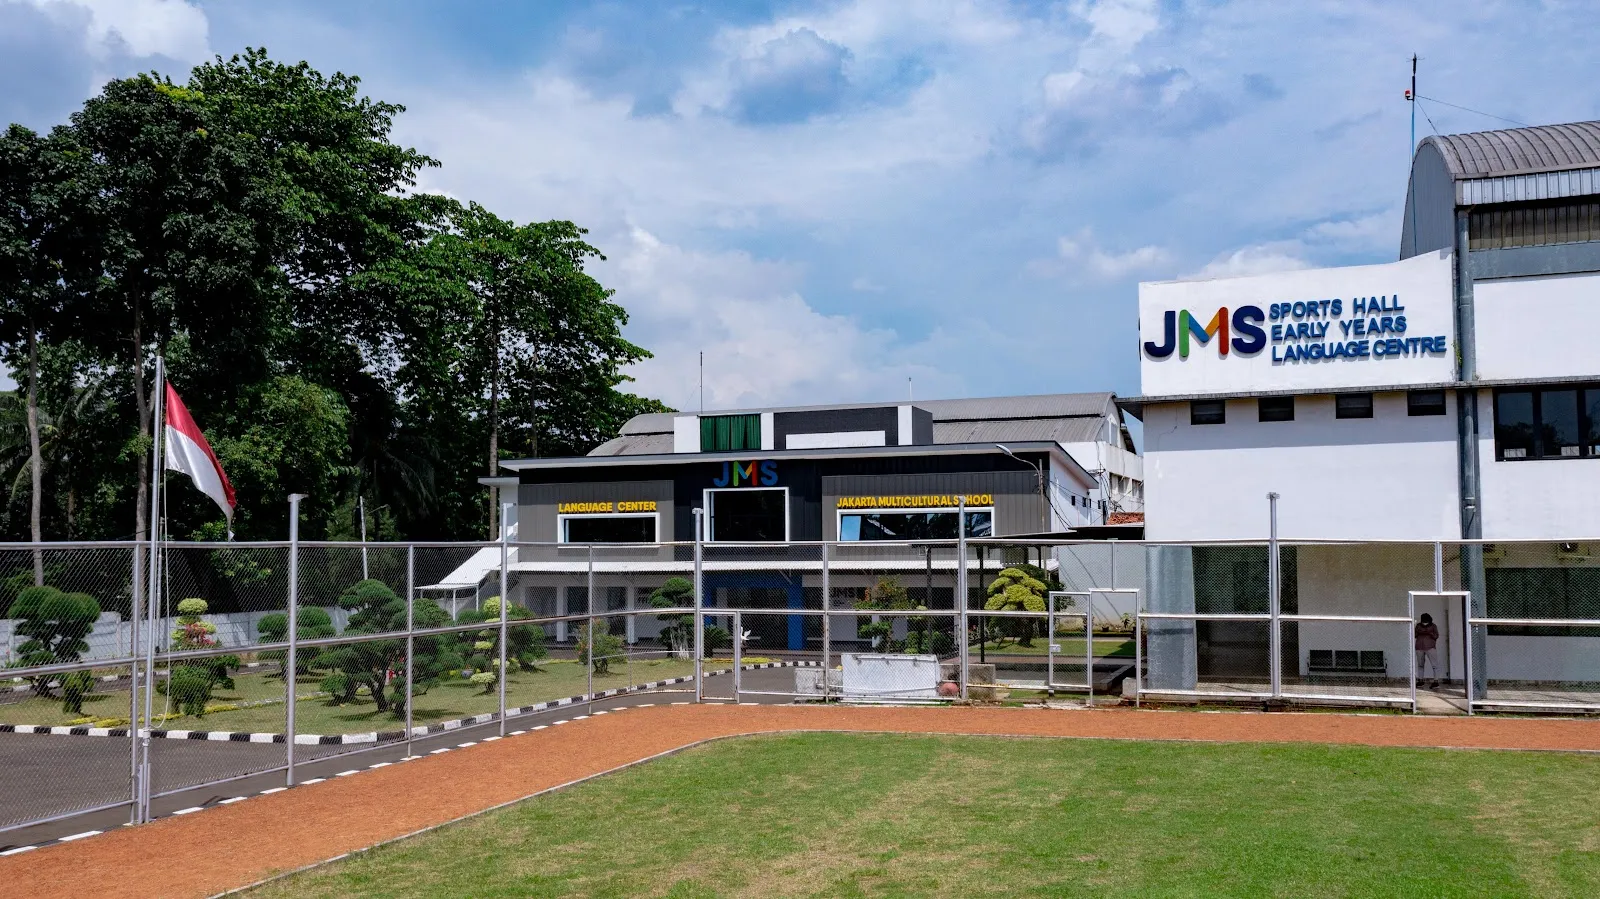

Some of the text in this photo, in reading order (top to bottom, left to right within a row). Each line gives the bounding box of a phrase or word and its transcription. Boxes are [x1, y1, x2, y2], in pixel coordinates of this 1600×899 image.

[1269, 295, 1404, 320] SPORTS HALL
[1144, 306, 1267, 357] JMS
[1271, 316, 1407, 341] EARLY YEARS
[1272, 336, 1447, 362] LANGUAGE CENTRE
[713, 460, 779, 487] JMS
[558, 501, 657, 513] LANGUAGE CENTER
[836, 494, 994, 507] JAKARTA MULTICULTURAL SHOOL
